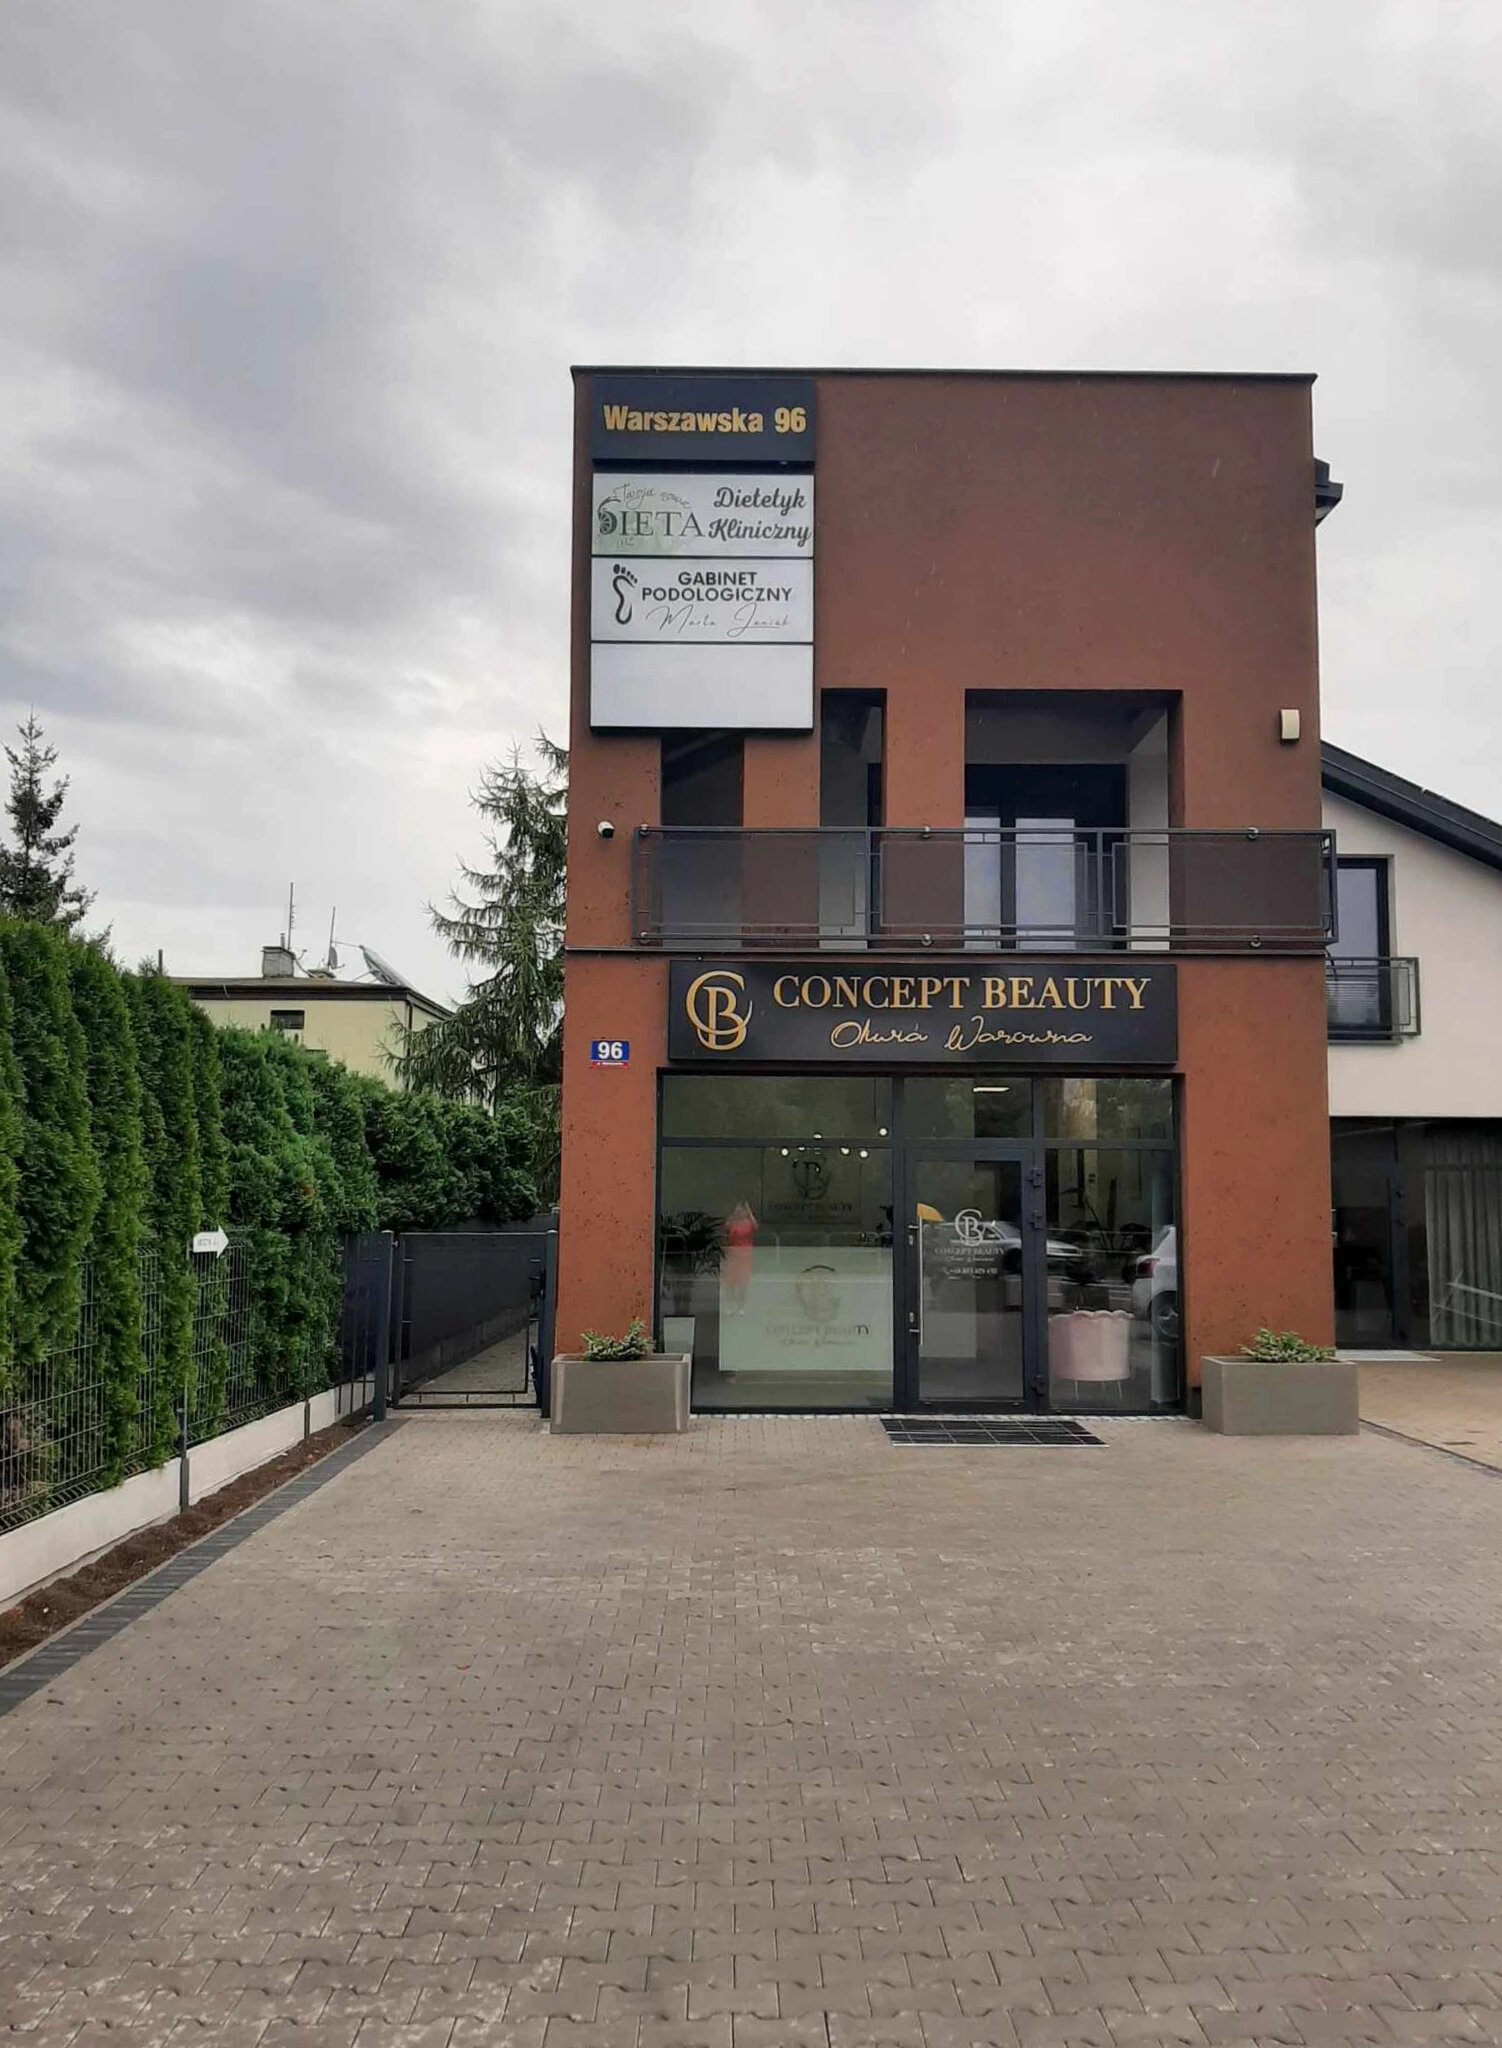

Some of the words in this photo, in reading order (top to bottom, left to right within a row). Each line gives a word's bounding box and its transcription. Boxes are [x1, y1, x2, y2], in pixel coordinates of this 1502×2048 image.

[603, 404, 764, 433] Warszawska
[773, 406, 807, 434] 96
[713, 486, 806, 516] Dietetyk
[707, 518, 812, 548] Kliniczny
[677, 571, 758, 586] GABINET
[641, 587, 793, 602] PODOLOGICZNY
[773, 975, 970, 1009] CONCEPT
[981, 976, 1152, 1010] BEAUTY
[597, 1041, 623, 1060] 96
